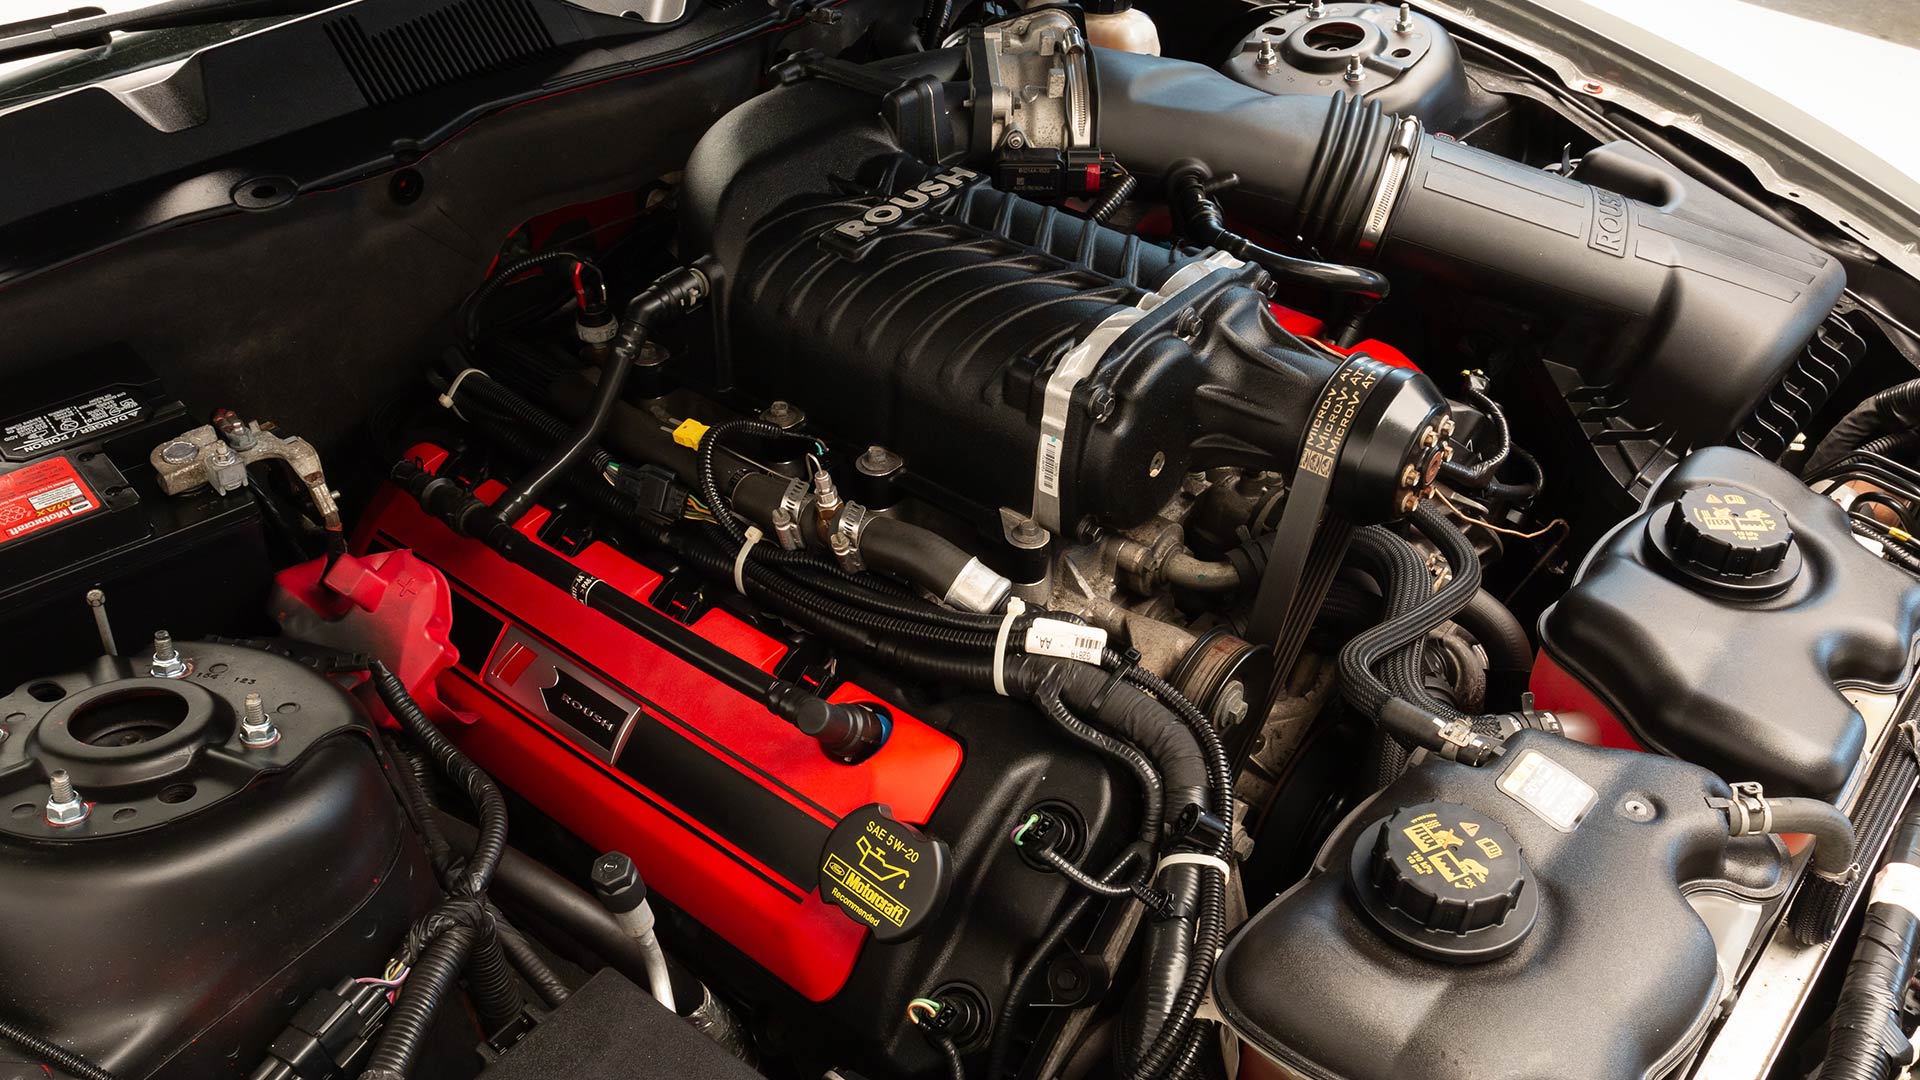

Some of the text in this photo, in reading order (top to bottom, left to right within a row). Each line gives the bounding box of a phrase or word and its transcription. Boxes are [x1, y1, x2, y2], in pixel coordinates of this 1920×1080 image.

[835, 166, 979, 241] ROUSH
[80, 414, 128, 434] DANGER
[23, 434, 68, 452] POISON
[6, 506, 70, 536] Motorcraft
[36, 500, 73, 516] MAX
[560, 692, 615, 732] ROUSH
[866, 820, 920, 864] SAE 5W-20
[846, 872, 905, 923] Motorcraft
[1463, 877, 1477, 890] OK
[831, 887, 880, 927] Recommended
